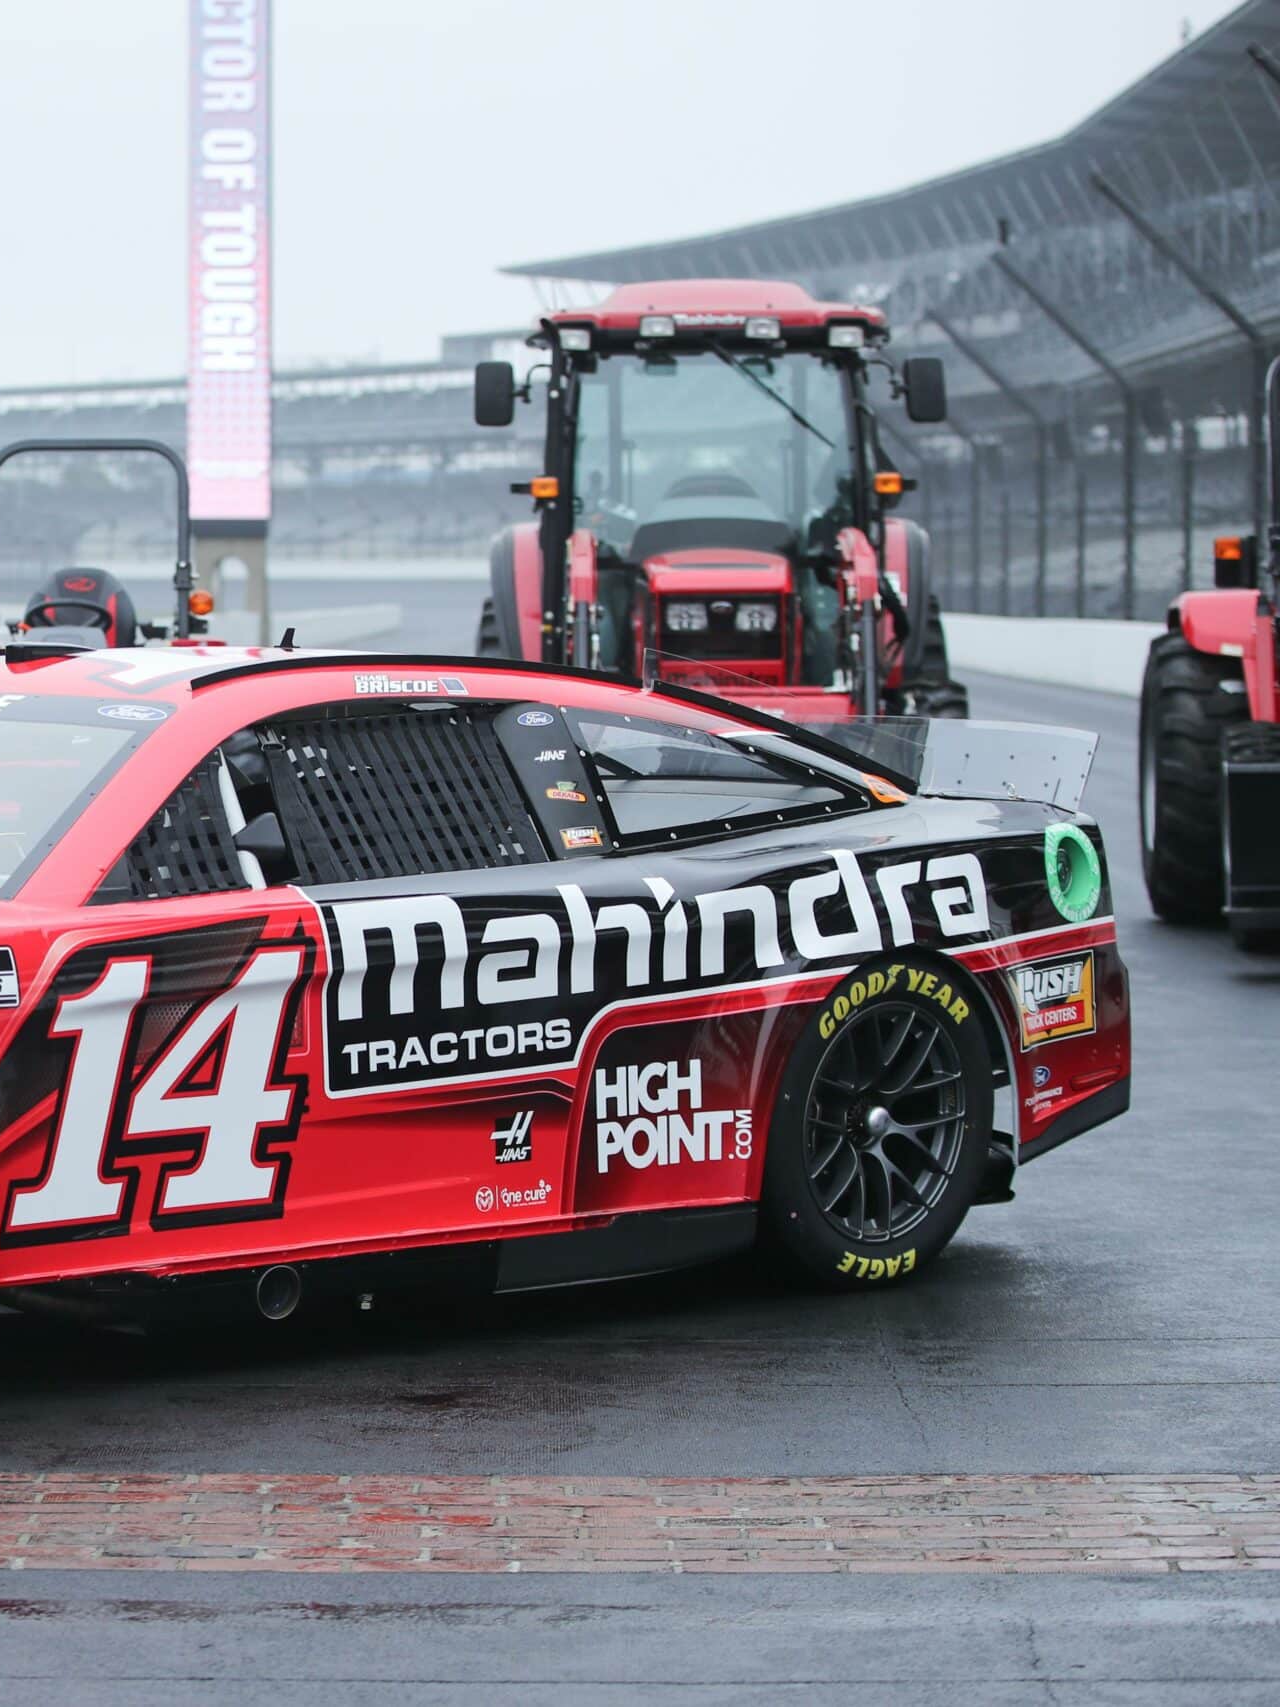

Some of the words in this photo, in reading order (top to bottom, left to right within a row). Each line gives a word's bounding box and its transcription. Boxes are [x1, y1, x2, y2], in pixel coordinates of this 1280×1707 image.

[201, 129, 257, 190] OF
[201, 205, 257, 372] TOUGH
[356, 680, 438, 693] BRISCOE
[1044, 1006, 1077, 1026] CENTERS
[343, 1018, 572, 1073] TRACTORS
[5, 946, 307, 1232] 14
[595, 1059, 703, 1119] HIGH
[495, 1147, 532, 1161] HAAS
[596, 1110, 735, 1173] POINT
[836, 1248, 917, 1280] EAGLE
